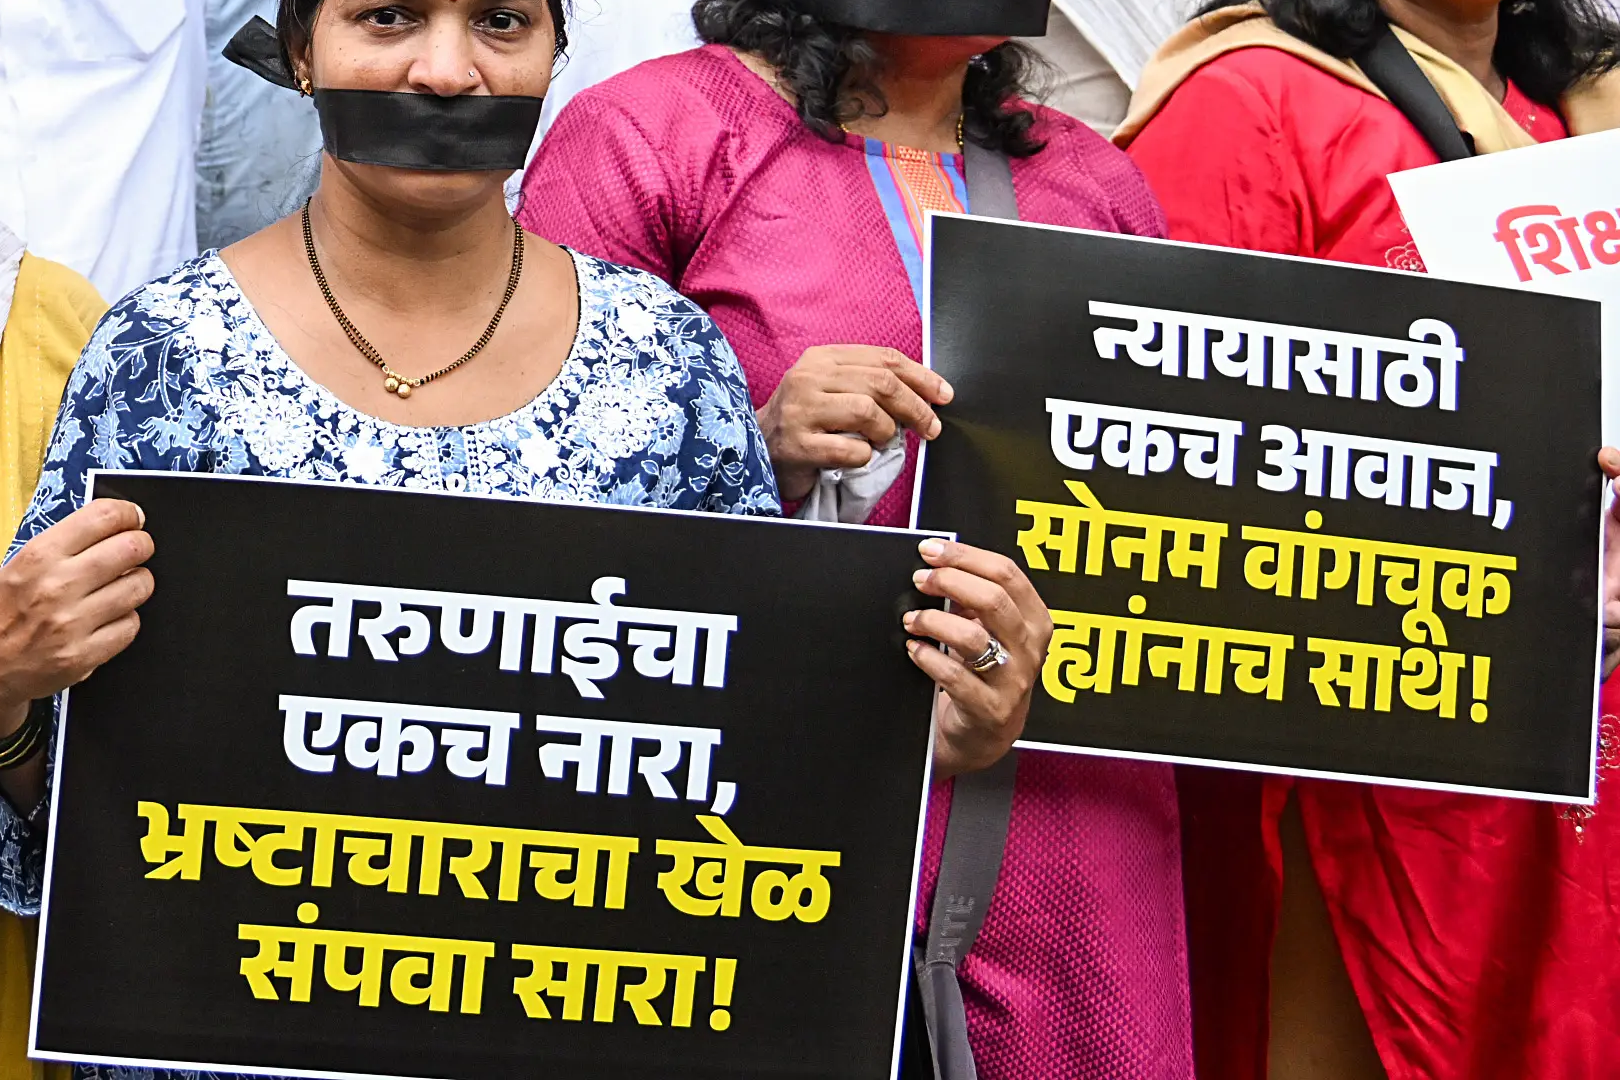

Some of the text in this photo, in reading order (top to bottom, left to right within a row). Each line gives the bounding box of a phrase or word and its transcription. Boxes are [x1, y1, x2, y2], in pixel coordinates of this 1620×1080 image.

[1089, 301, 1463, 411] न्यायासाठी
[1046, 398, 1511, 529] एकच आवाज,
[1015, 480, 1516, 646] सोनम वांगचूक
[287, 577, 737, 698] तरुणाईचा
[1043, 595, 1490, 723] ह्यांनाच साथ!
[279, 695, 736, 815] एकच नारा,
[138, 801, 840, 922] भ्रष्टाचाराचा खेळ
[238, 902, 737, 1031] संपवा सारा!
